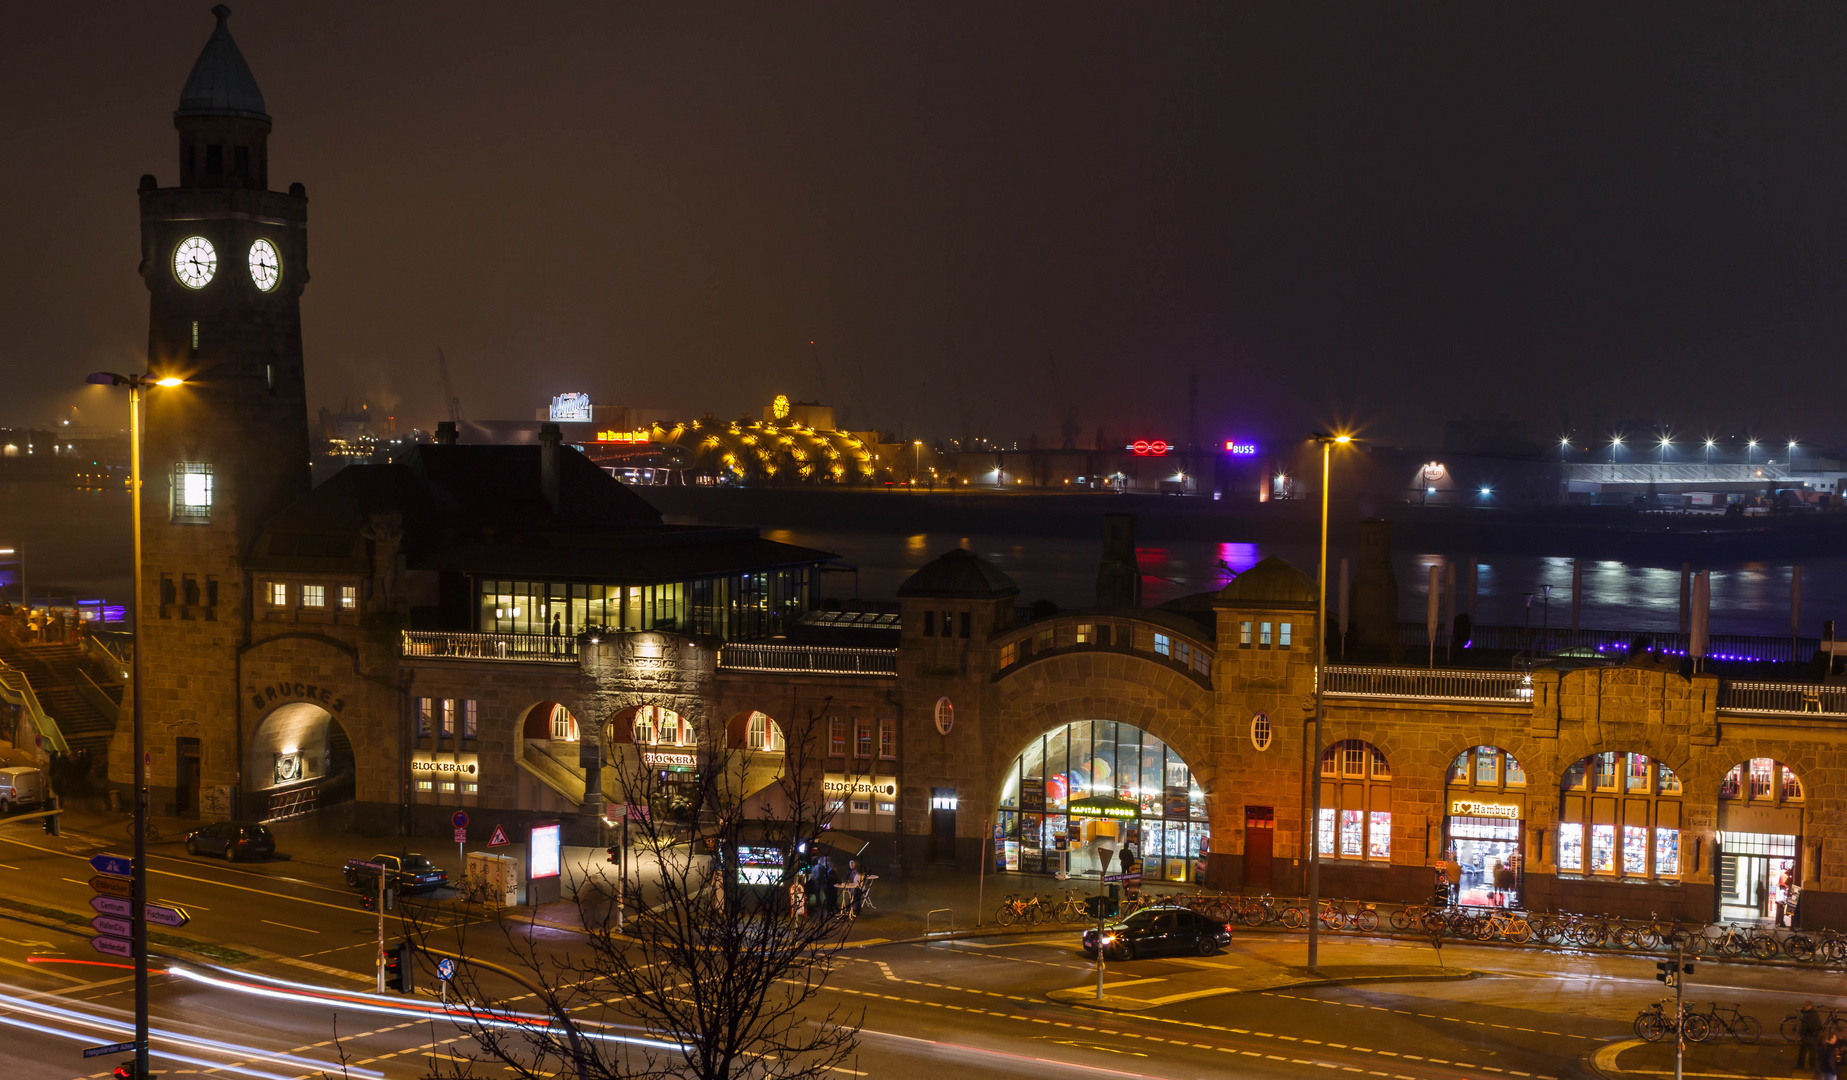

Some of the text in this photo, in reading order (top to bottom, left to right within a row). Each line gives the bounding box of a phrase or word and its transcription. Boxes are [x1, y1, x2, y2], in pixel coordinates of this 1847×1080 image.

[1233, 445, 1254, 454] BUSS
[1473, 804, 1517, 818] Hamburg
[100, 901, 124, 911] Centrum
[147, 909, 176, 921] Fischmarkt
[100, 921, 126, 934] HafenCity
